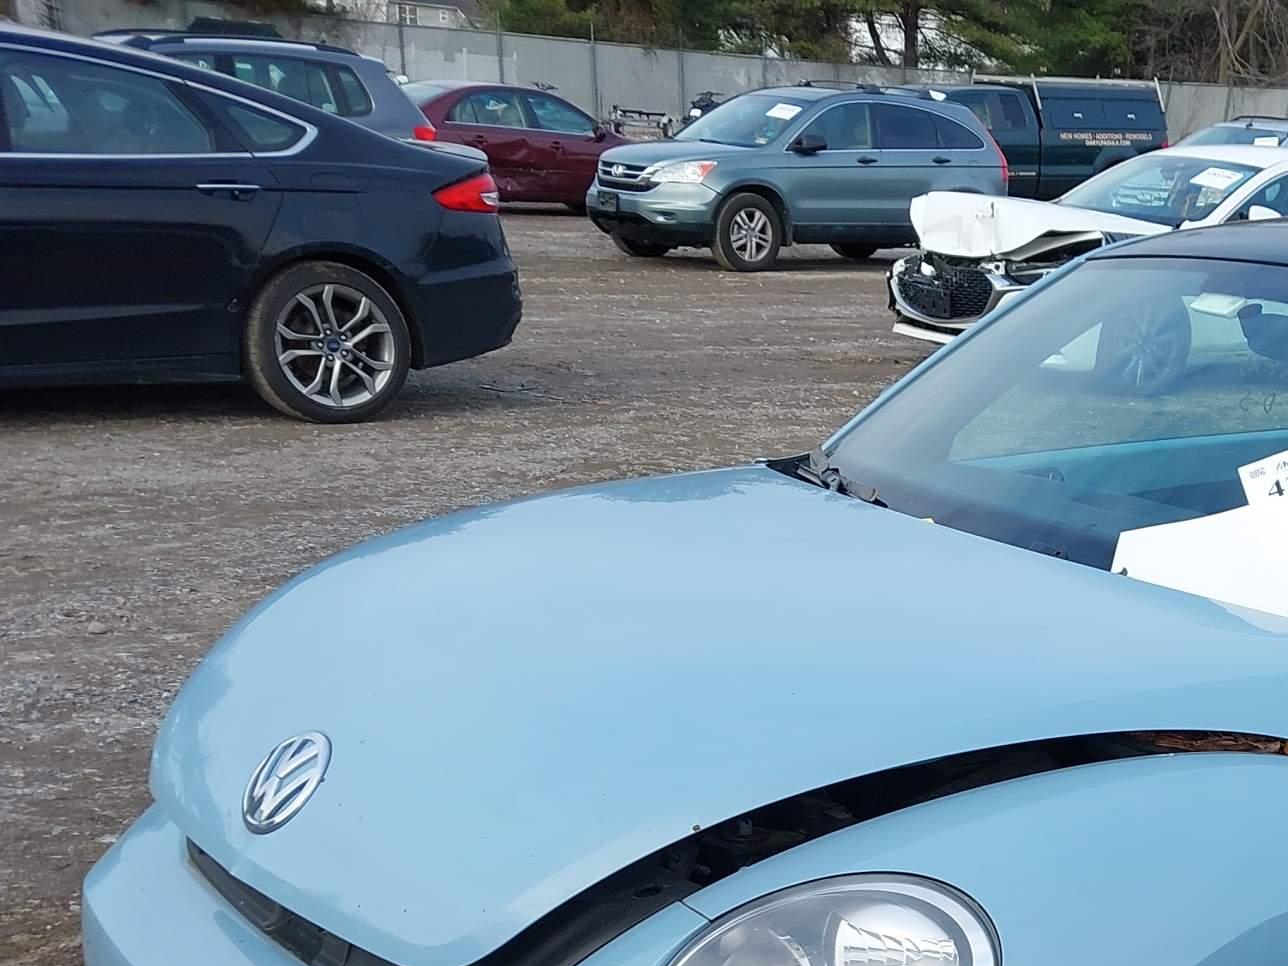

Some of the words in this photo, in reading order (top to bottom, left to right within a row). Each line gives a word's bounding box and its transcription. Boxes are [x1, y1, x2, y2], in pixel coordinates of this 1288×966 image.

[1060, 132, 1073, 140] NEW
[1073, 132, 1093, 140] HOMES
[1096, 132, 1122, 140] ADDITIONS
[1125, 132, 1152, 140] REMODELS
